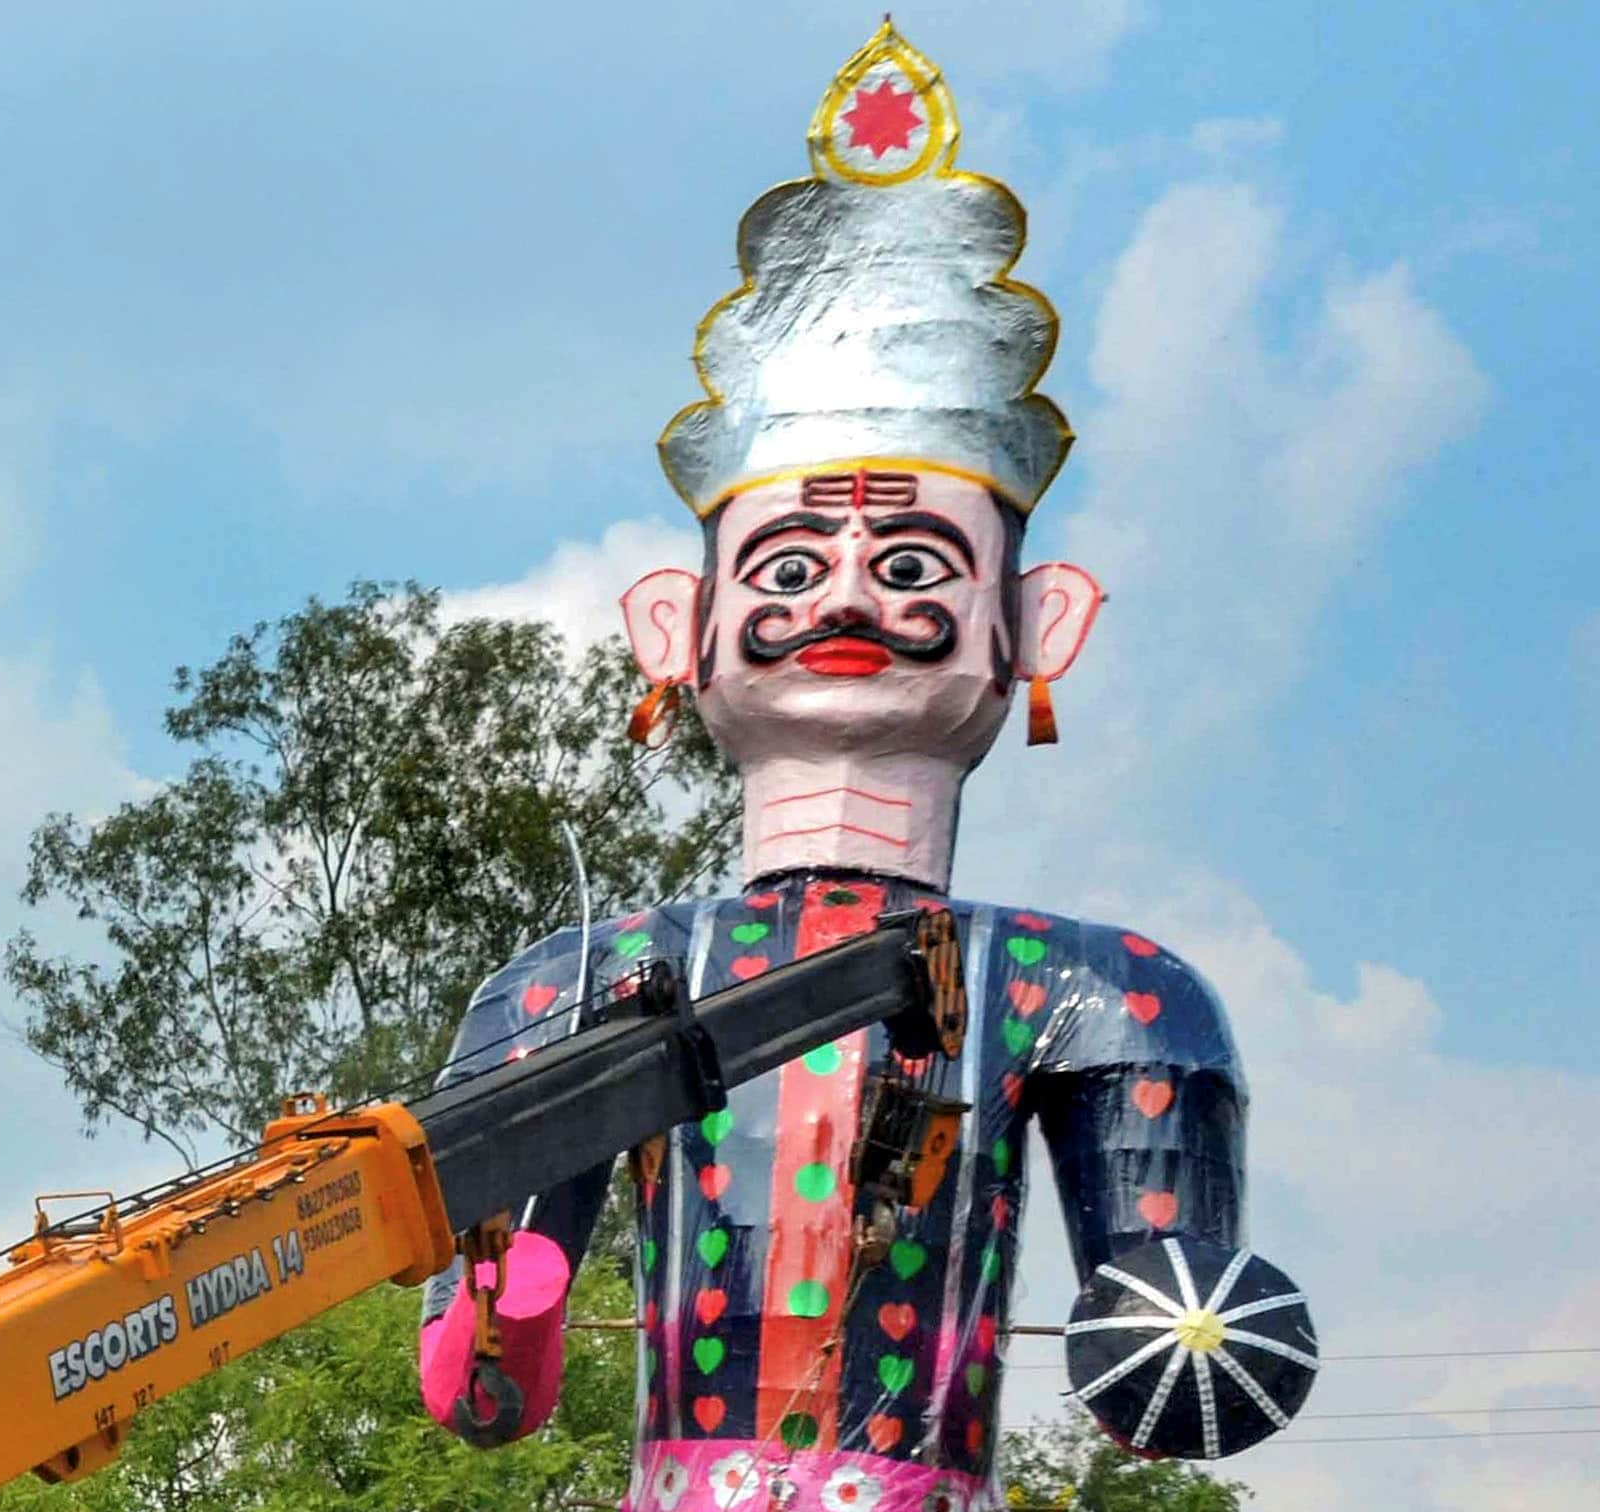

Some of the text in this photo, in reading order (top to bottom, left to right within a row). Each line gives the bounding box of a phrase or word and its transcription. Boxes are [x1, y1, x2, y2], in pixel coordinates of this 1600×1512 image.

[48, 1293, 179, 1402] ESCORTS
[186, 1246, 271, 1329] HYDRA
[273, 1229, 304, 1283] 14
